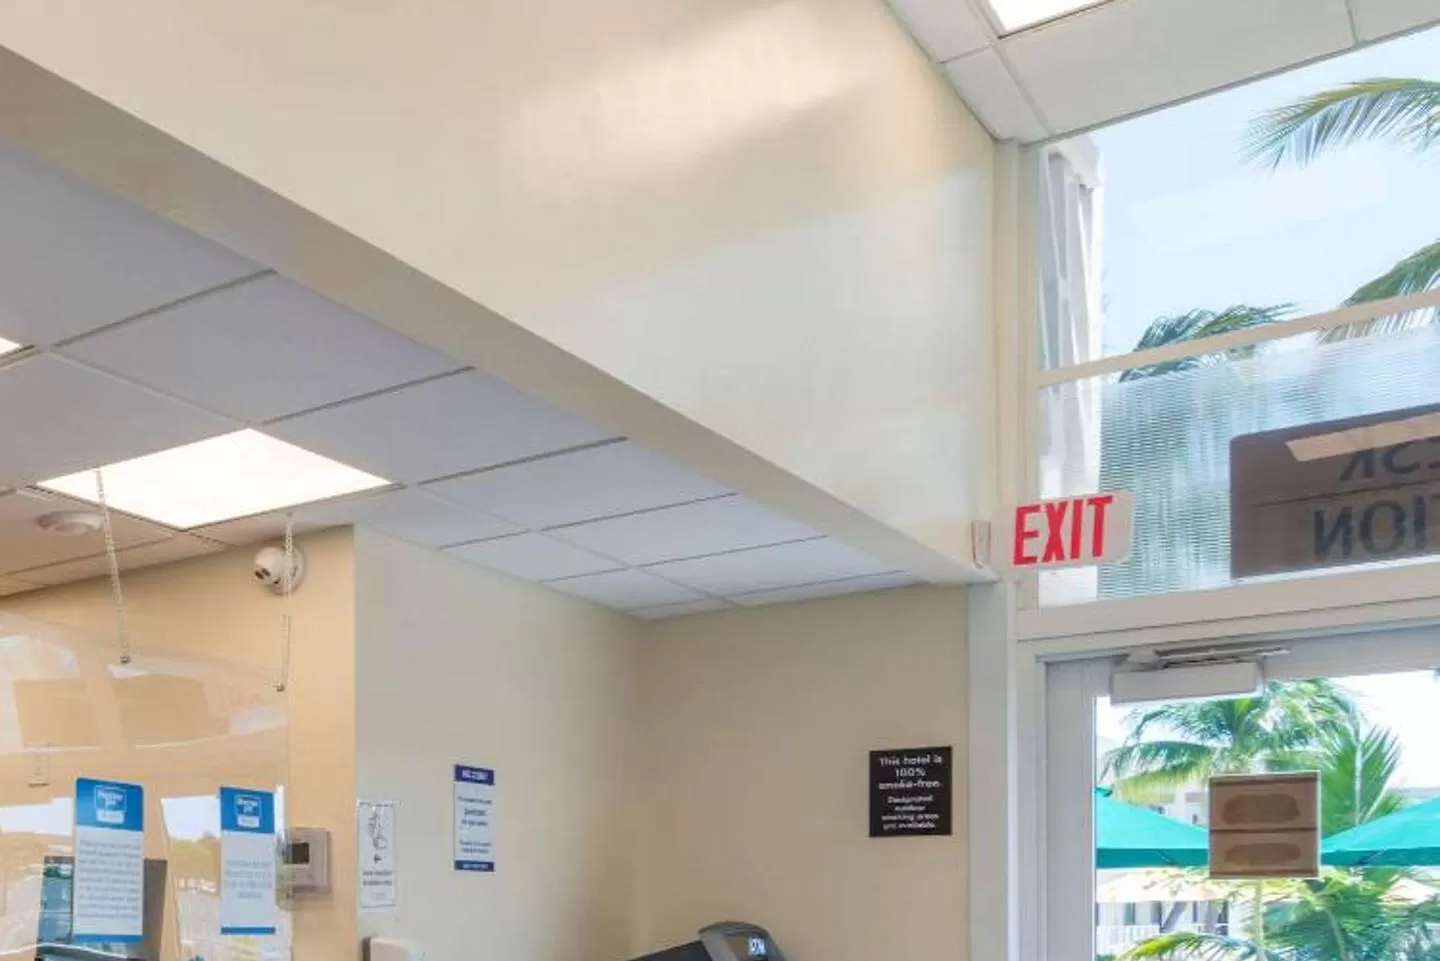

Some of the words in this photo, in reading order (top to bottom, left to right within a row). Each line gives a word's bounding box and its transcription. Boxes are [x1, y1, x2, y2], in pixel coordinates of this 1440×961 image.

[1013, 495, 1114, 566] EXIT
[880, 756, 901, 767] This
[903, 754, 931, 765] hotel
[895, 767, 926, 777] 100%
